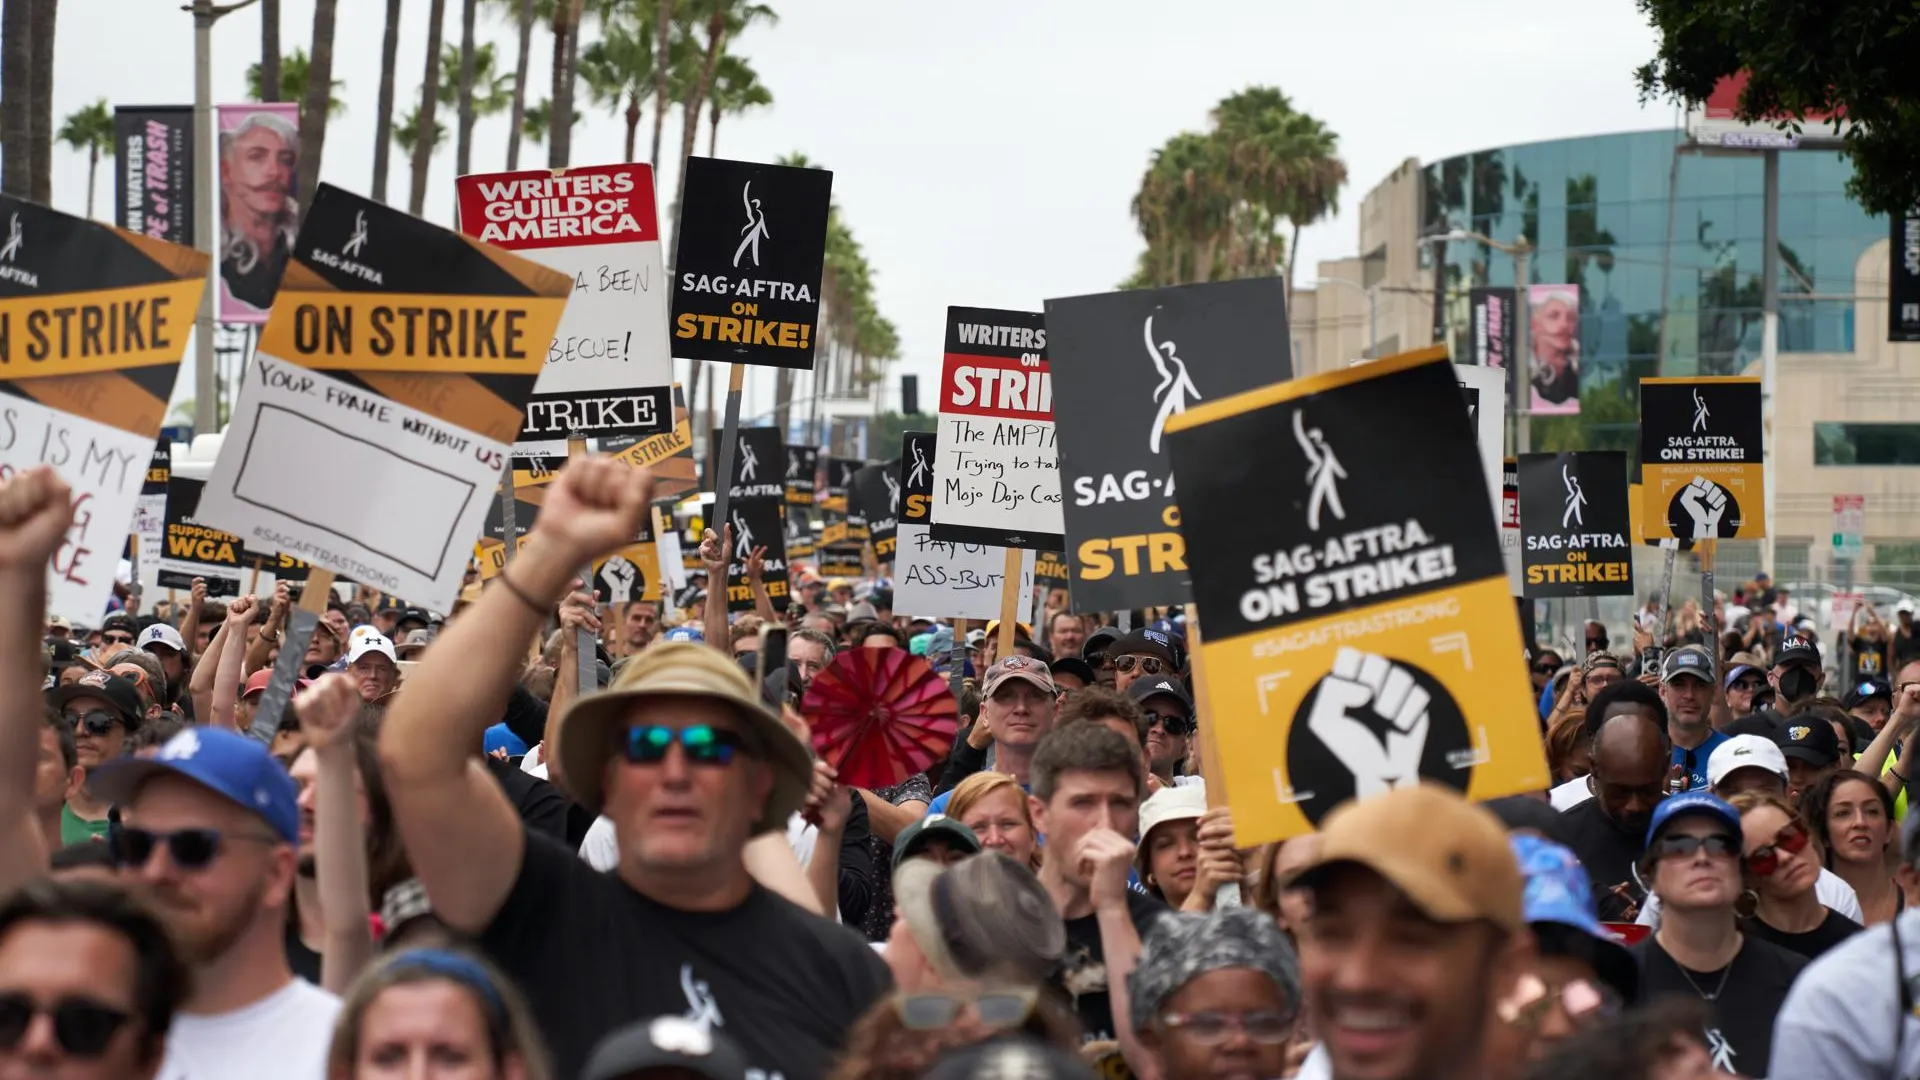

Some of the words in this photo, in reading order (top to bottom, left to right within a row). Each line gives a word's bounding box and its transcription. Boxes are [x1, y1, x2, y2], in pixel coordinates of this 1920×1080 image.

[146, 120, 169, 189] TRASH
[477, 172, 635, 201] WRITERS
[484, 197, 593, 223] GUILD
[594, 198, 630, 214] OF
[479, 212, 642, 244] AMERICA
[731, 302, 758, 317] ON
[27, 298, 170, 361] STRIKE
[294, 304, 353, 355] ON
[369, 308, 527, 359] STRIKE
[675, 313, 811, 349] STRIKE!
[958, 323, 1047, 349] WRITERS
[545, 331, 631, 364] BECUE!
[1021, 353, 1040, 367] ON
[259, 360, 317, 397] YOUR
[326, 386, 393, 424] FRAME
[475, 446, 504, 472] US
[631, 429, 684, 466] STRIKE
[950, 420, 985, 444] The
[993, 422, 1057, 449] AMPT
[40, 422, 71, 466] IS
[80, 437, 136, 495] MY
[950, 450, 1004, 479] Trying
[1014, 456, 1029, 469] to
[1660, 448, 1683, 460] ON
[1686, 447, 1745, 460] STRIKE!
[945, 478, 983, 507] Mojo
[992, 481, 1024, 510] Dojo
[168, 523, 240, 543] SUPPORTS
[168, 535, 236, 564] WGA
[1566, 551, 1588, 562] ON
[1239, 581, 1301, 623] ON
[1303, 544, 1458, 608] STRIKE!
[1526, 562, 1629, 585] STRIKE!
[1251, 596, 1462, 659] #SAGAFTRASTRONG
